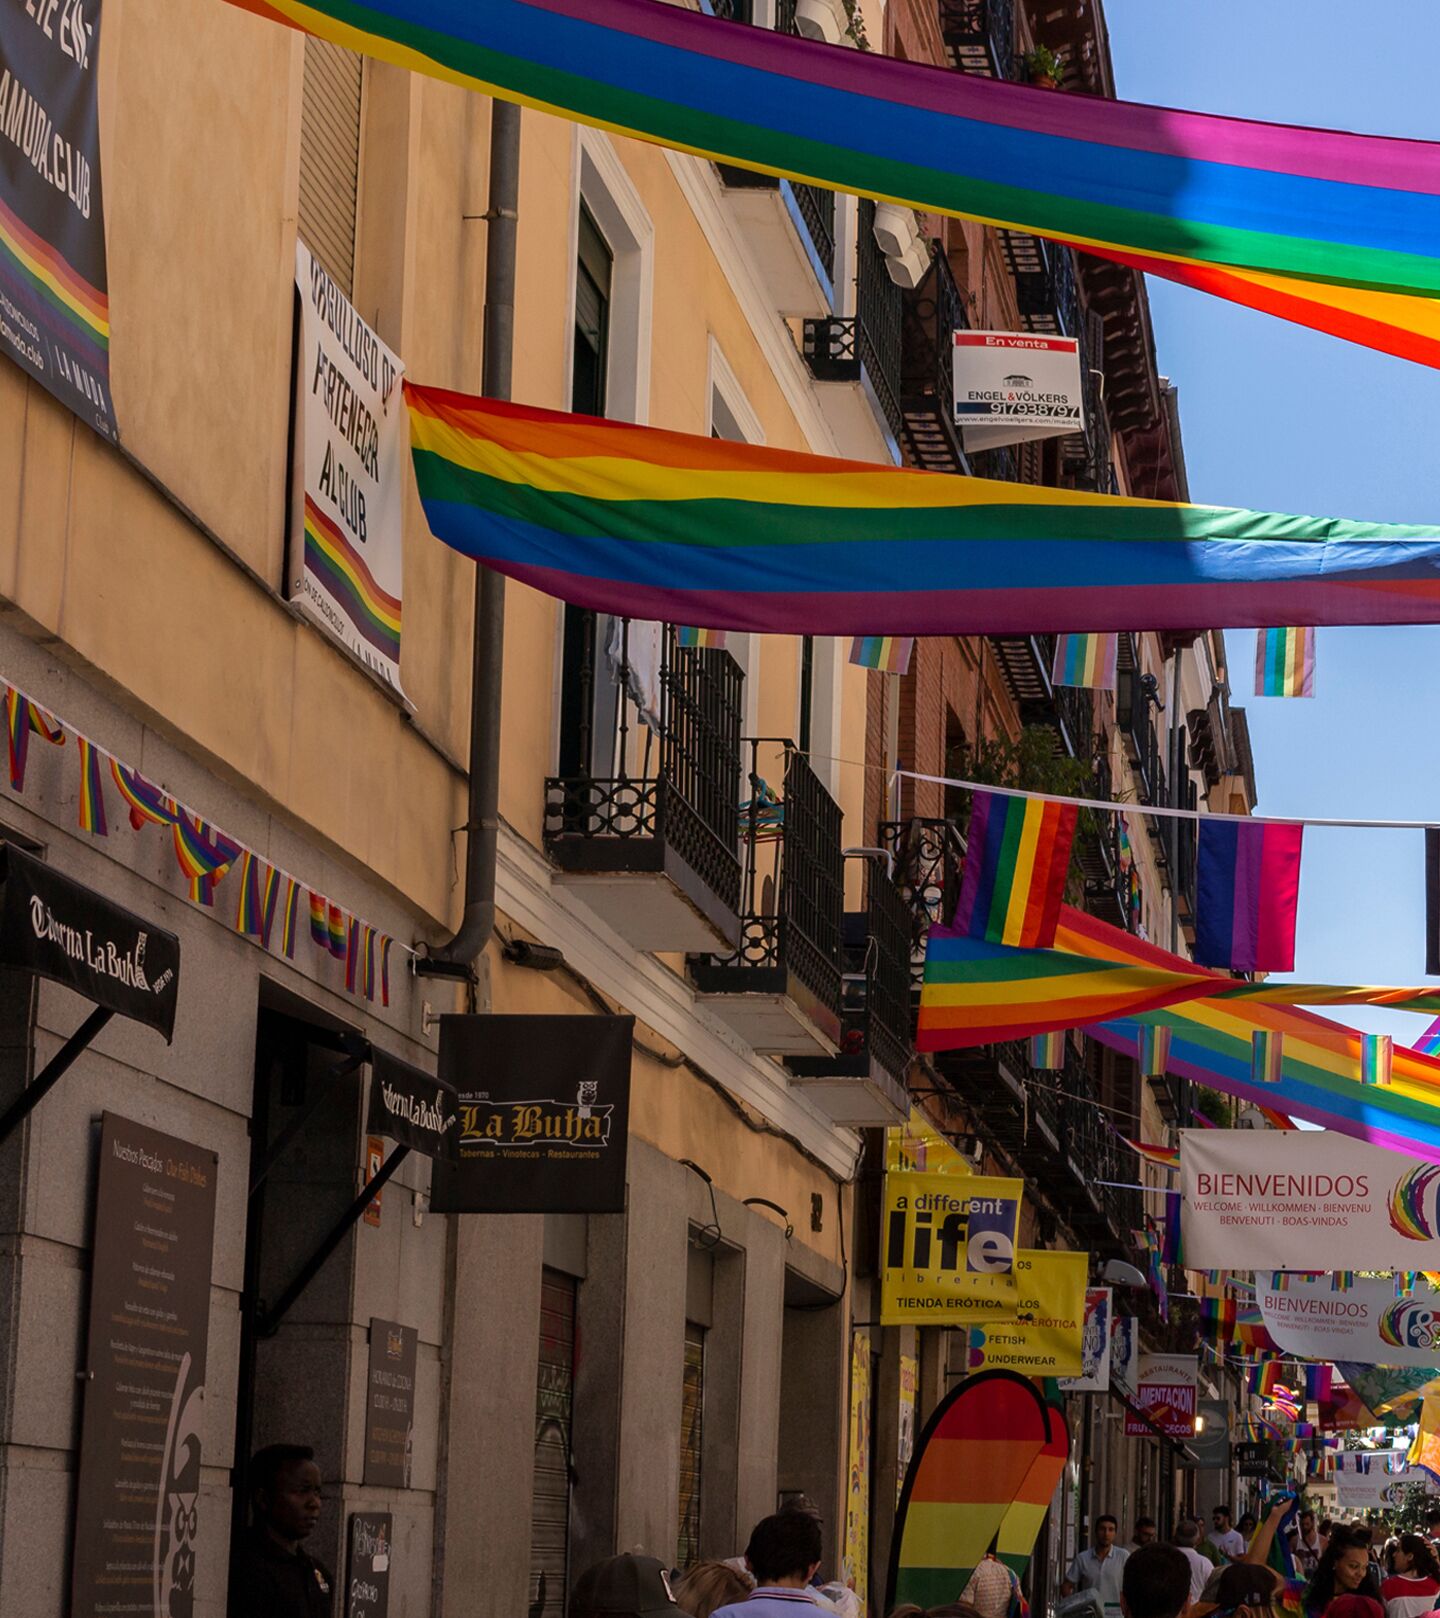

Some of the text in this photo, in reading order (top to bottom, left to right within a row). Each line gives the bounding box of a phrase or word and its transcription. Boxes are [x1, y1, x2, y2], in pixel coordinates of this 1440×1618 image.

[985, 336, 1048, 349] En venta
[990, 402, 1077, 418] 917938797
[338, 461, 367, 544] CLUB
[86, 930, 106, 974] La
[458, 1104, 503, 1138] La
[511, 1103, 601, 1143] Buha
[459, 1149, 600, 1159] Tabernas Vinotecas Restaurantes
[1197, 1173, 1369, 1198] BIENVENIDOS
[896, 1194, 1002, 1215] a different
[1193, 1202, 1371, 1213] WELCOME WILLKOMMEN BIENVENU
[1219, 1216, 1349, 1227] BENVENUTI BOAS-VINDAS
[887, 1210, 1014, 1275] life
[896, 1296, 1002, 1309] TIENDA ERÓTICA
[1264, 1295, 1369, 1318] BIENVENIDOS
[1032, 1318, 1077, 1329] ERÓTICA
[989, 1335, 1026, 1345] FETISH
[988, 1354, 1056, 1366] UNDERWEAR
